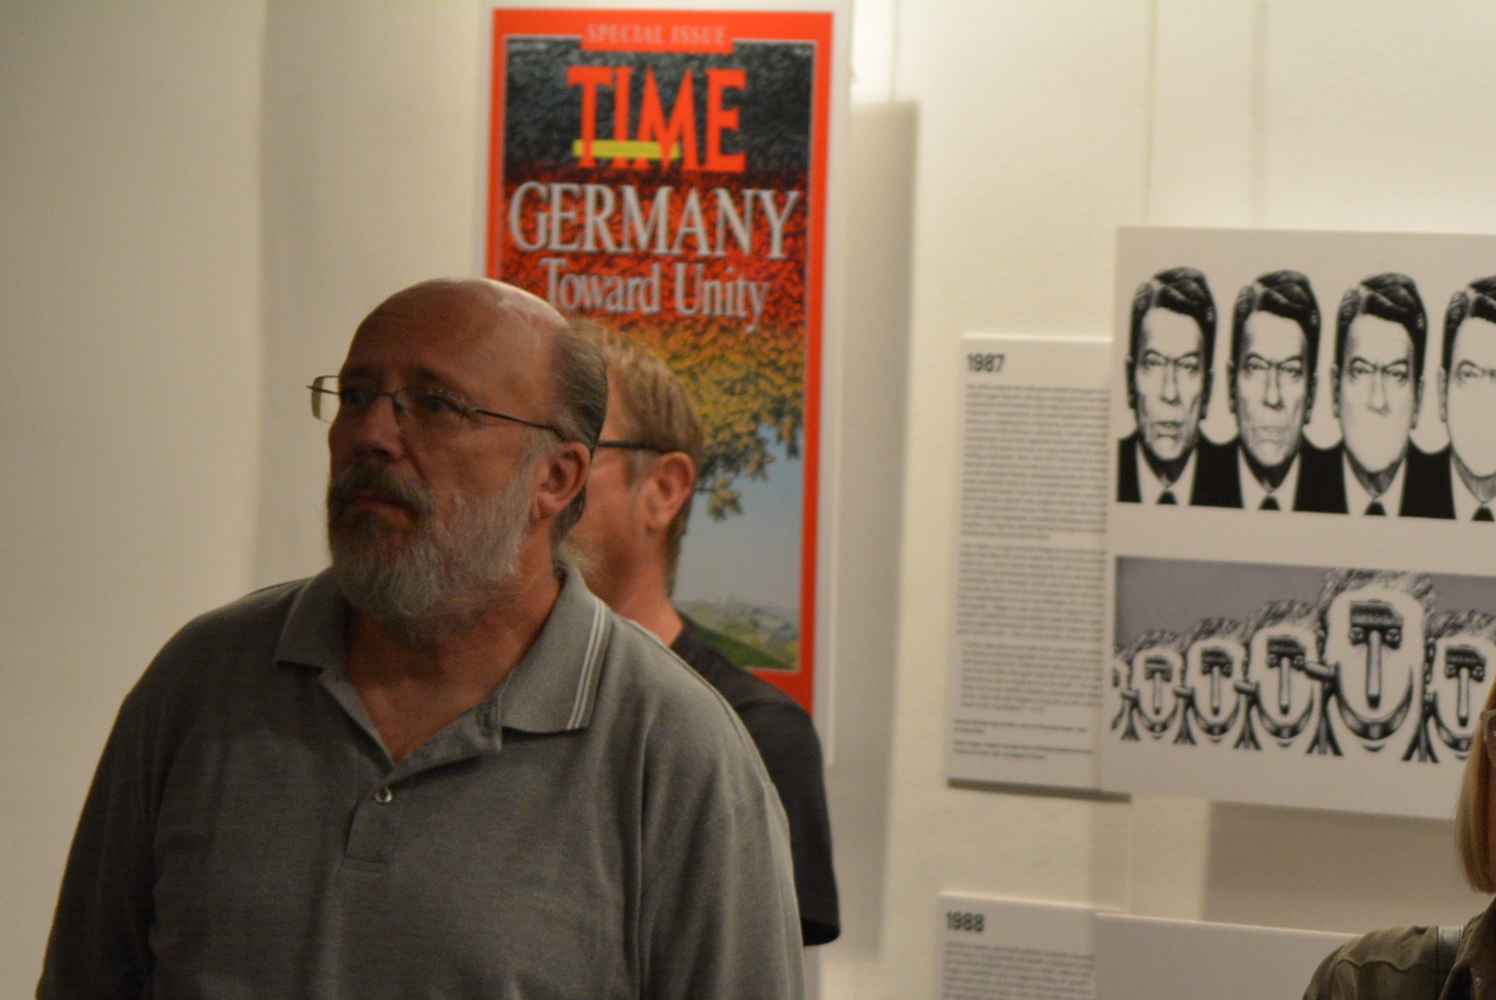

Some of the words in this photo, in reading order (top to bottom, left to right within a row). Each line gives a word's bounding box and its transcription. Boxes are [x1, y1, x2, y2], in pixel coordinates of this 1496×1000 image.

[585, 23, 663, 43] SPECIAL
[670, 25, 727, 46] ISSUE
[566, 65, 748, 173] TIME
[508, 180, 801, 260] GERMANY
[539, 258, 662, 316] Toward
[674, 263, 771, 333] Unity
[967, 353, 1005, 373] 1987
[945, 911, 985, 933] 1988
